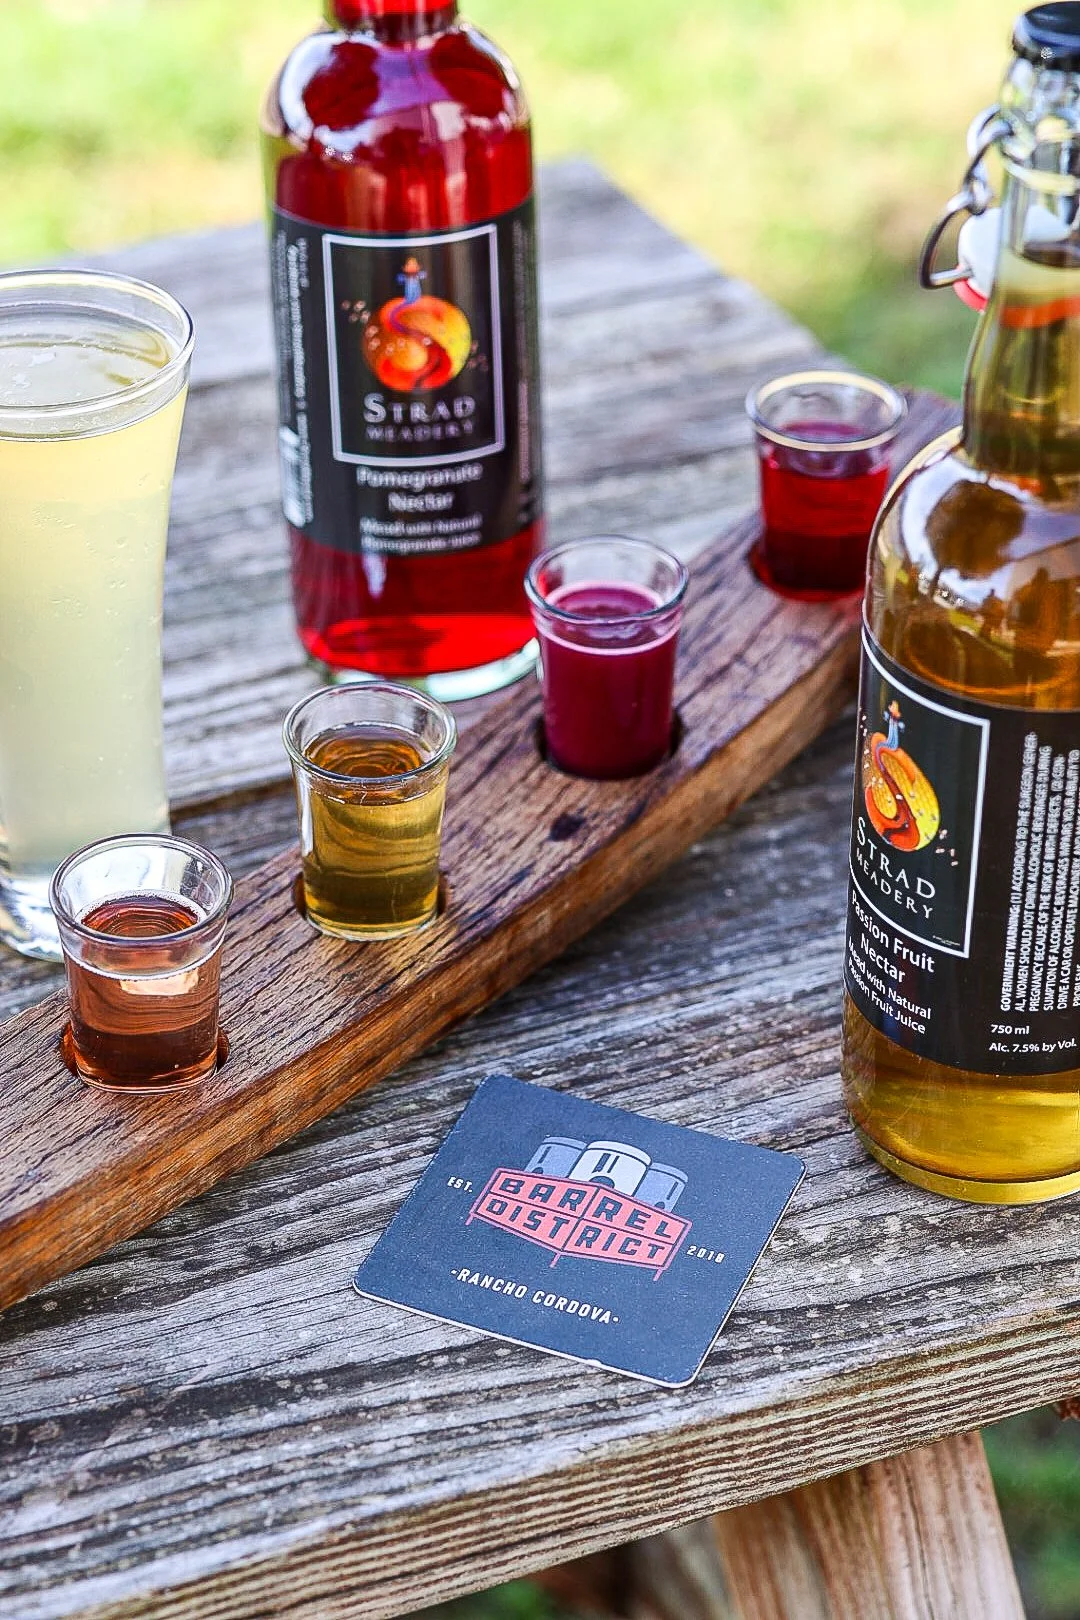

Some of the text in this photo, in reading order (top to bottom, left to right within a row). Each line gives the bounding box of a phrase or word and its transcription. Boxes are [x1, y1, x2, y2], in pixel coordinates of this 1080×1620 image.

[363, 392, 476, 423] STRAD
[856, 816, 936, 899] STRAD
[856, 847, 934, 919] MEADERY
[852, 889, 935, 974] Passion Fruit
[1023, 909, 1035, 929] NOT
[1037, 911, 1049, 923] OF
[1049, 906, 1065, 954] ALCOHOLIC
[860, 932, 906, 983] Nectar
[1019, 929, 1033, 964] SHOULD
[1033, 924, 1048, 961] BECAUSE
[1048, 954, 1059, 967] OF
[866, 969, 886, 995] with
[887, 987, 932, 1021] Natural
[1000, 951, 1016, 1012] GOVERNMENT
[1016, 965, 1029, 998] WOMEN
[1029, 961, 1044, 1012] PREGNANCY
[1043, 967, 1057, 1011] SUMPTION
[1057, 984, 1070, 1010] DRIVE
[1059, 976, 1070, 984] A
[871, 990, 894, 1018] Fruit
[894, 1010, 927, 1035] Juice
[990, 1023, 1030, 1036] 750 ml
[988, 1037, 1078, 1053] Alc. 7.5% by Vol.
[447, 1176, 473, 1193] EST.
[499, 1177, 672, 1239] BARREL
[485, 1198, 666, 1260] DISTRICT
[686, 1245, 725, 1263] 2018
